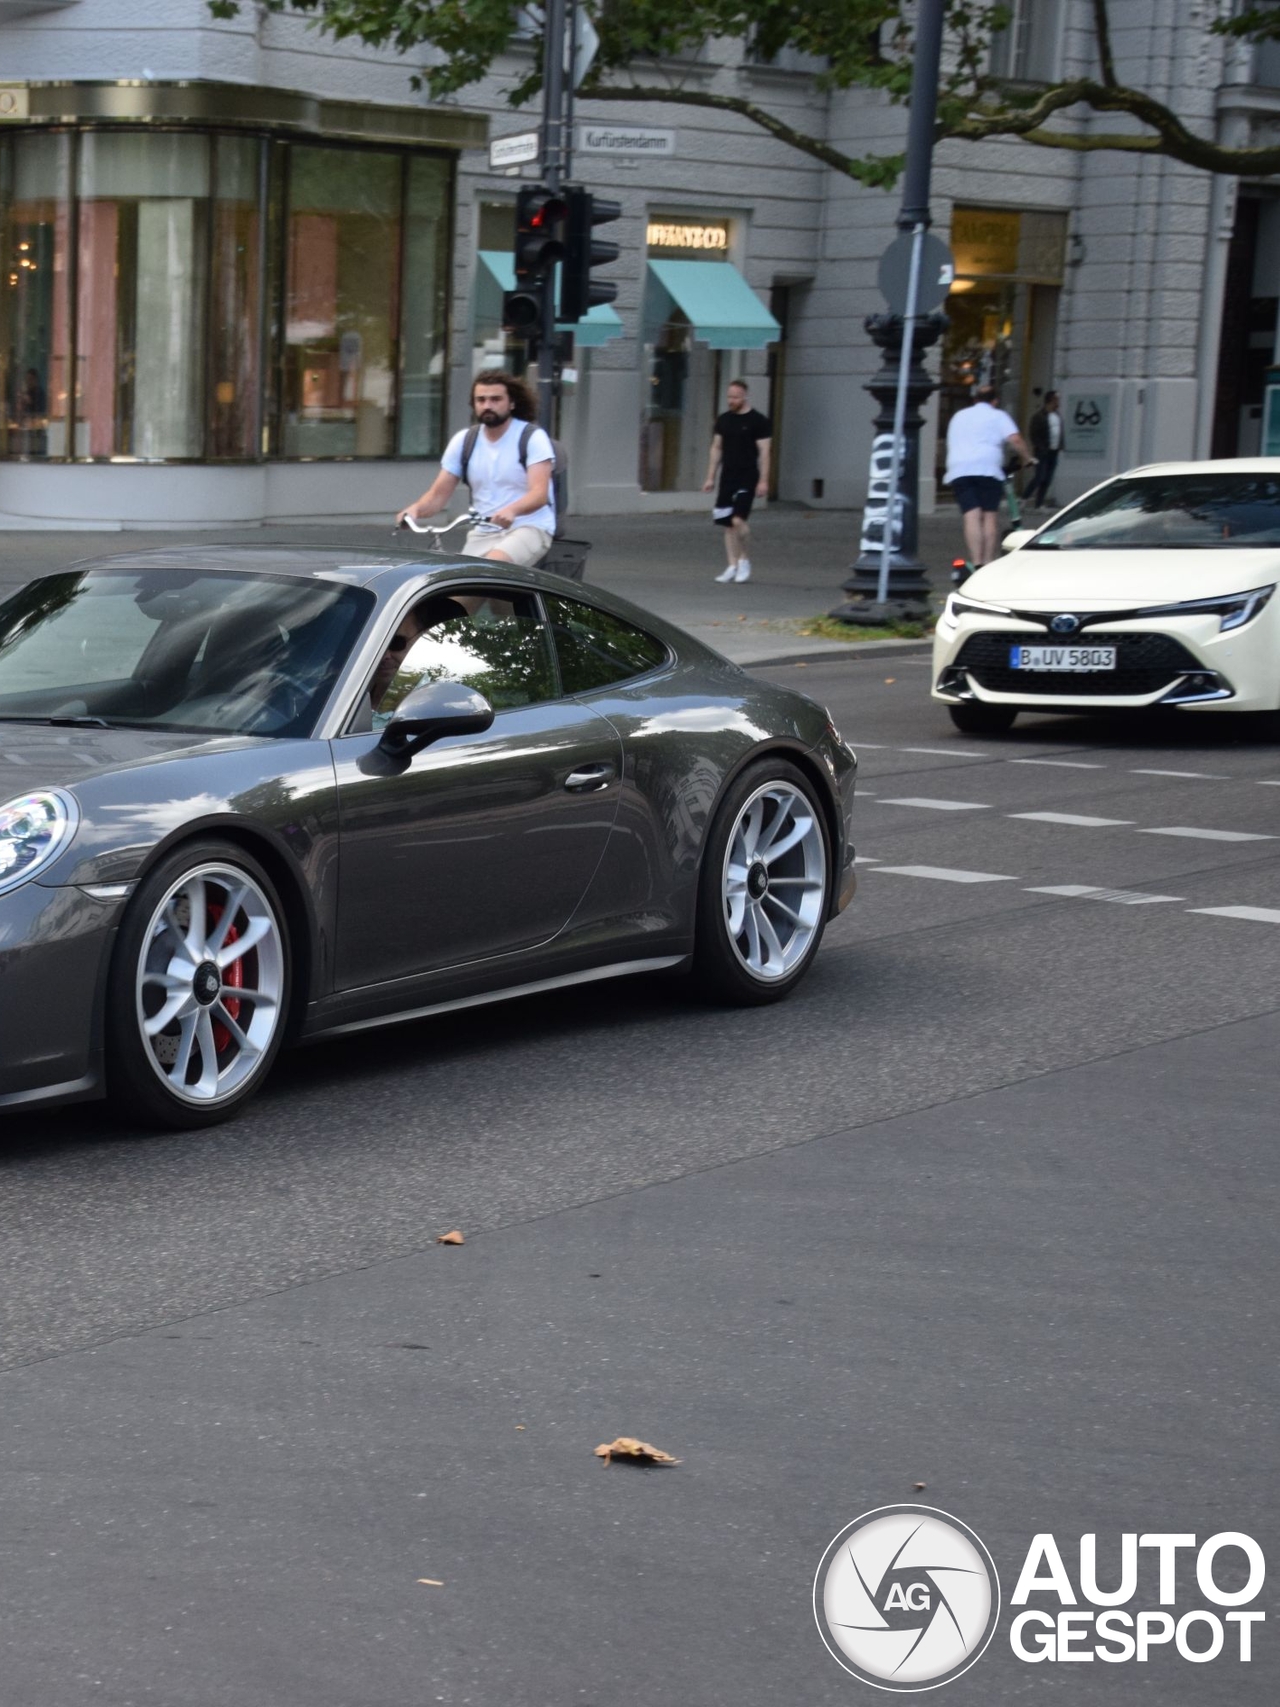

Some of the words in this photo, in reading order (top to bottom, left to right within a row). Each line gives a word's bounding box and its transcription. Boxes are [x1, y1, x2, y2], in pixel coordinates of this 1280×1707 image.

[586, 131, 667, 149] Kurfürstendamm
[1021, 649, 1031, 666] B
[1043, 649, 1066, 666] UV
[1069, 650, 1113, 667] 5803
